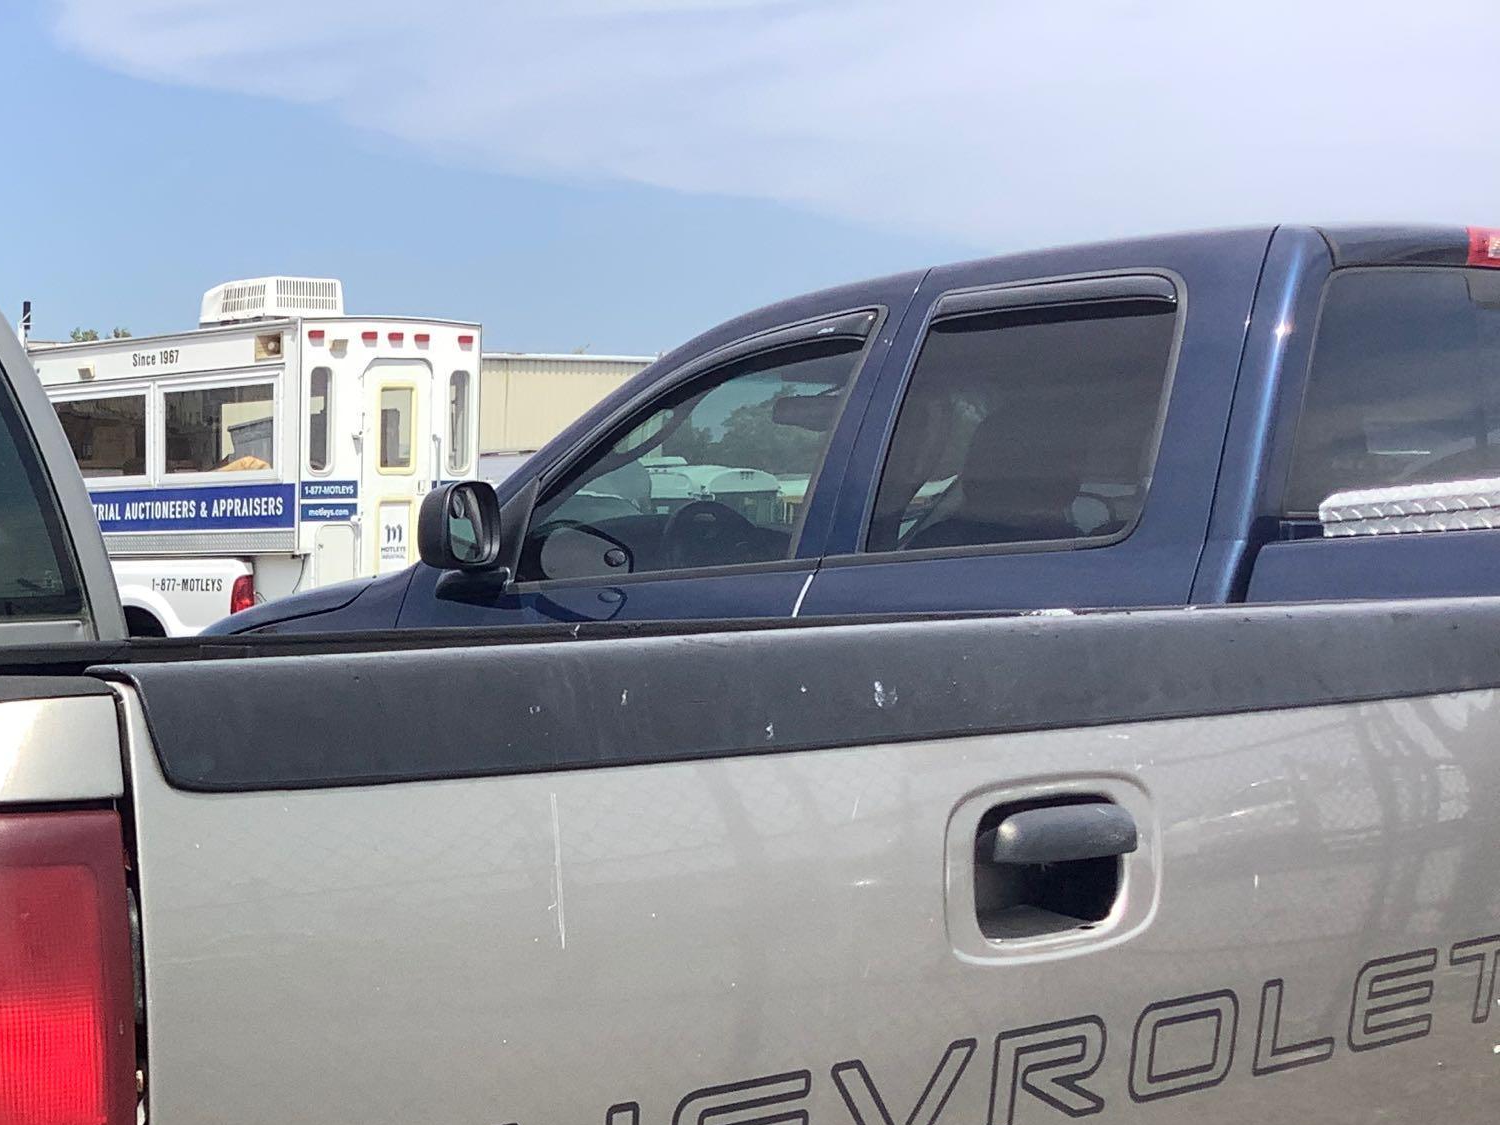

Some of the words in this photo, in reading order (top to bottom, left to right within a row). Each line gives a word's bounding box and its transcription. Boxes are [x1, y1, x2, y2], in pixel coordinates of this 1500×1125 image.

[132, 352, 156, 367] Since
[160, 350, 180, 364] 1967
[304, 485, 354, 495] 1-877-MOTLEYS
[124, 500, 196, 520] AUCTIONEERS
[200, 501, 208, 518] &
[212, 497, 283, 517] APPRAISERS
[308, 507, 349, 517] motleys.com
[152, 578, 223, 592] 1-877-MOTLEYS
